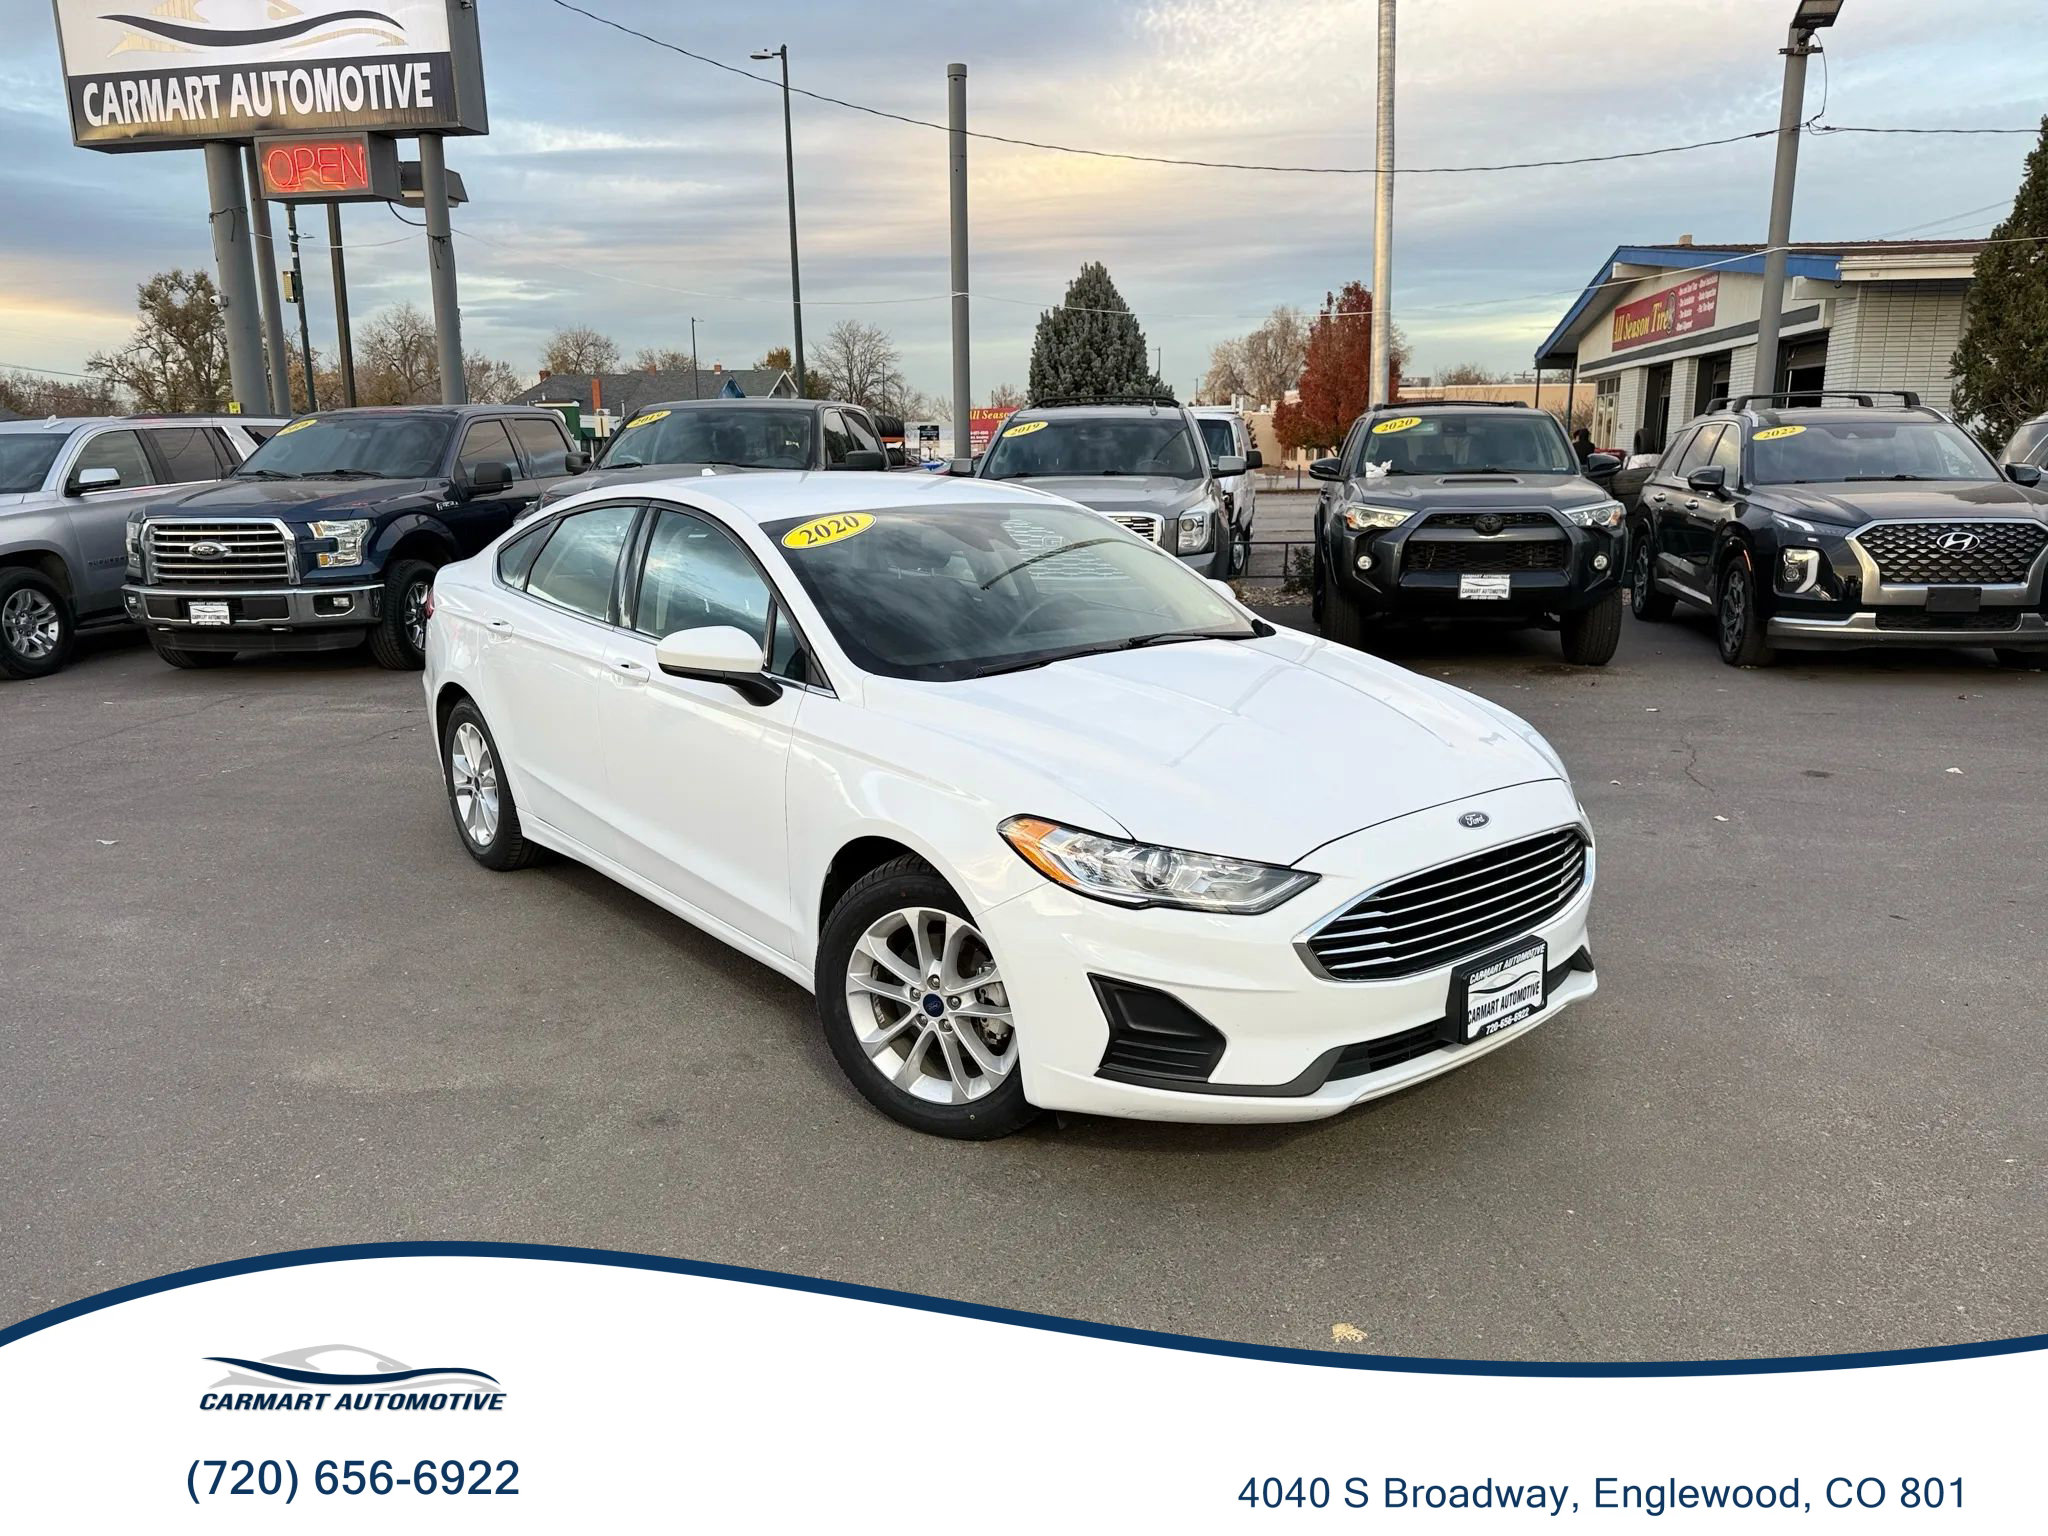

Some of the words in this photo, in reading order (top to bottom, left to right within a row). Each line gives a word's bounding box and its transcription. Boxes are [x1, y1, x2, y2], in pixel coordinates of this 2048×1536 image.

[83, 74, 221, 127] CARMART
[230, 62, 433, 118] AUTOMOTIVE
[267, 146, 366, 188] OPEN
[1623, 313, 1650, 341] Season
[1009, 423, 1041, 436] 2019
[1380, 418, 1413, 432] 2020
[1763, 427, 1797, 439] 2022
[799, 515, 860, 545] 2020
[1464, 813, 1485, 826] Ford
[1469, 961, 1504, 986] CARMART
[1502, 943, 1546, 971] AUTOMOTIVE
[1468, 998, 1500, 1025] CARMART
[1499, 981, 1540, 1012] AUTOMOTIVE
[1485, 1007, 1530, 1035] 720-656-6922
